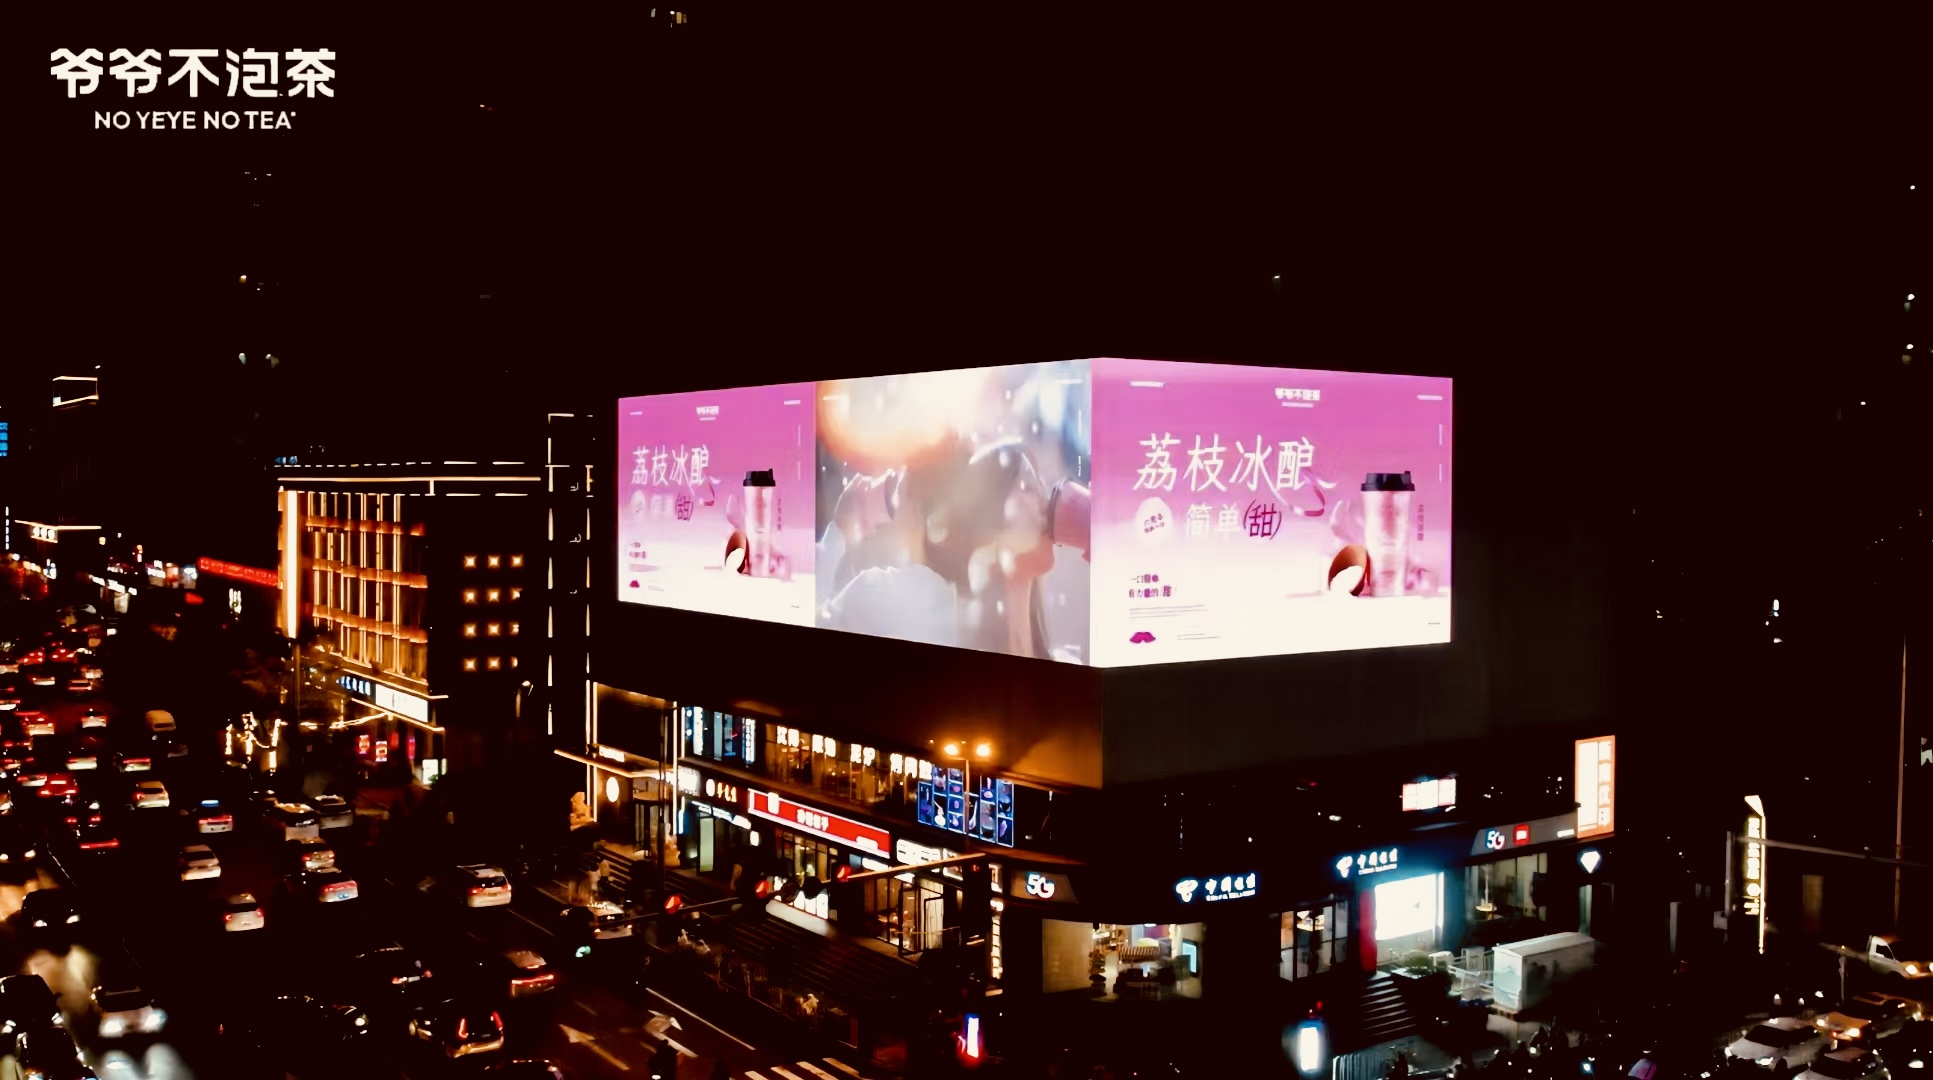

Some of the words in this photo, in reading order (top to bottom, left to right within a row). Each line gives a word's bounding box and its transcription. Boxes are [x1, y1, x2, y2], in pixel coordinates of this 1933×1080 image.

[630, 443, 721, 488] 荔枝冰酿
[1132, 432, 1337, 494] 荔枝冰酿
[1486, 830, 1505, 850] 5G
[1026, 874, 1055, 899] 5G
